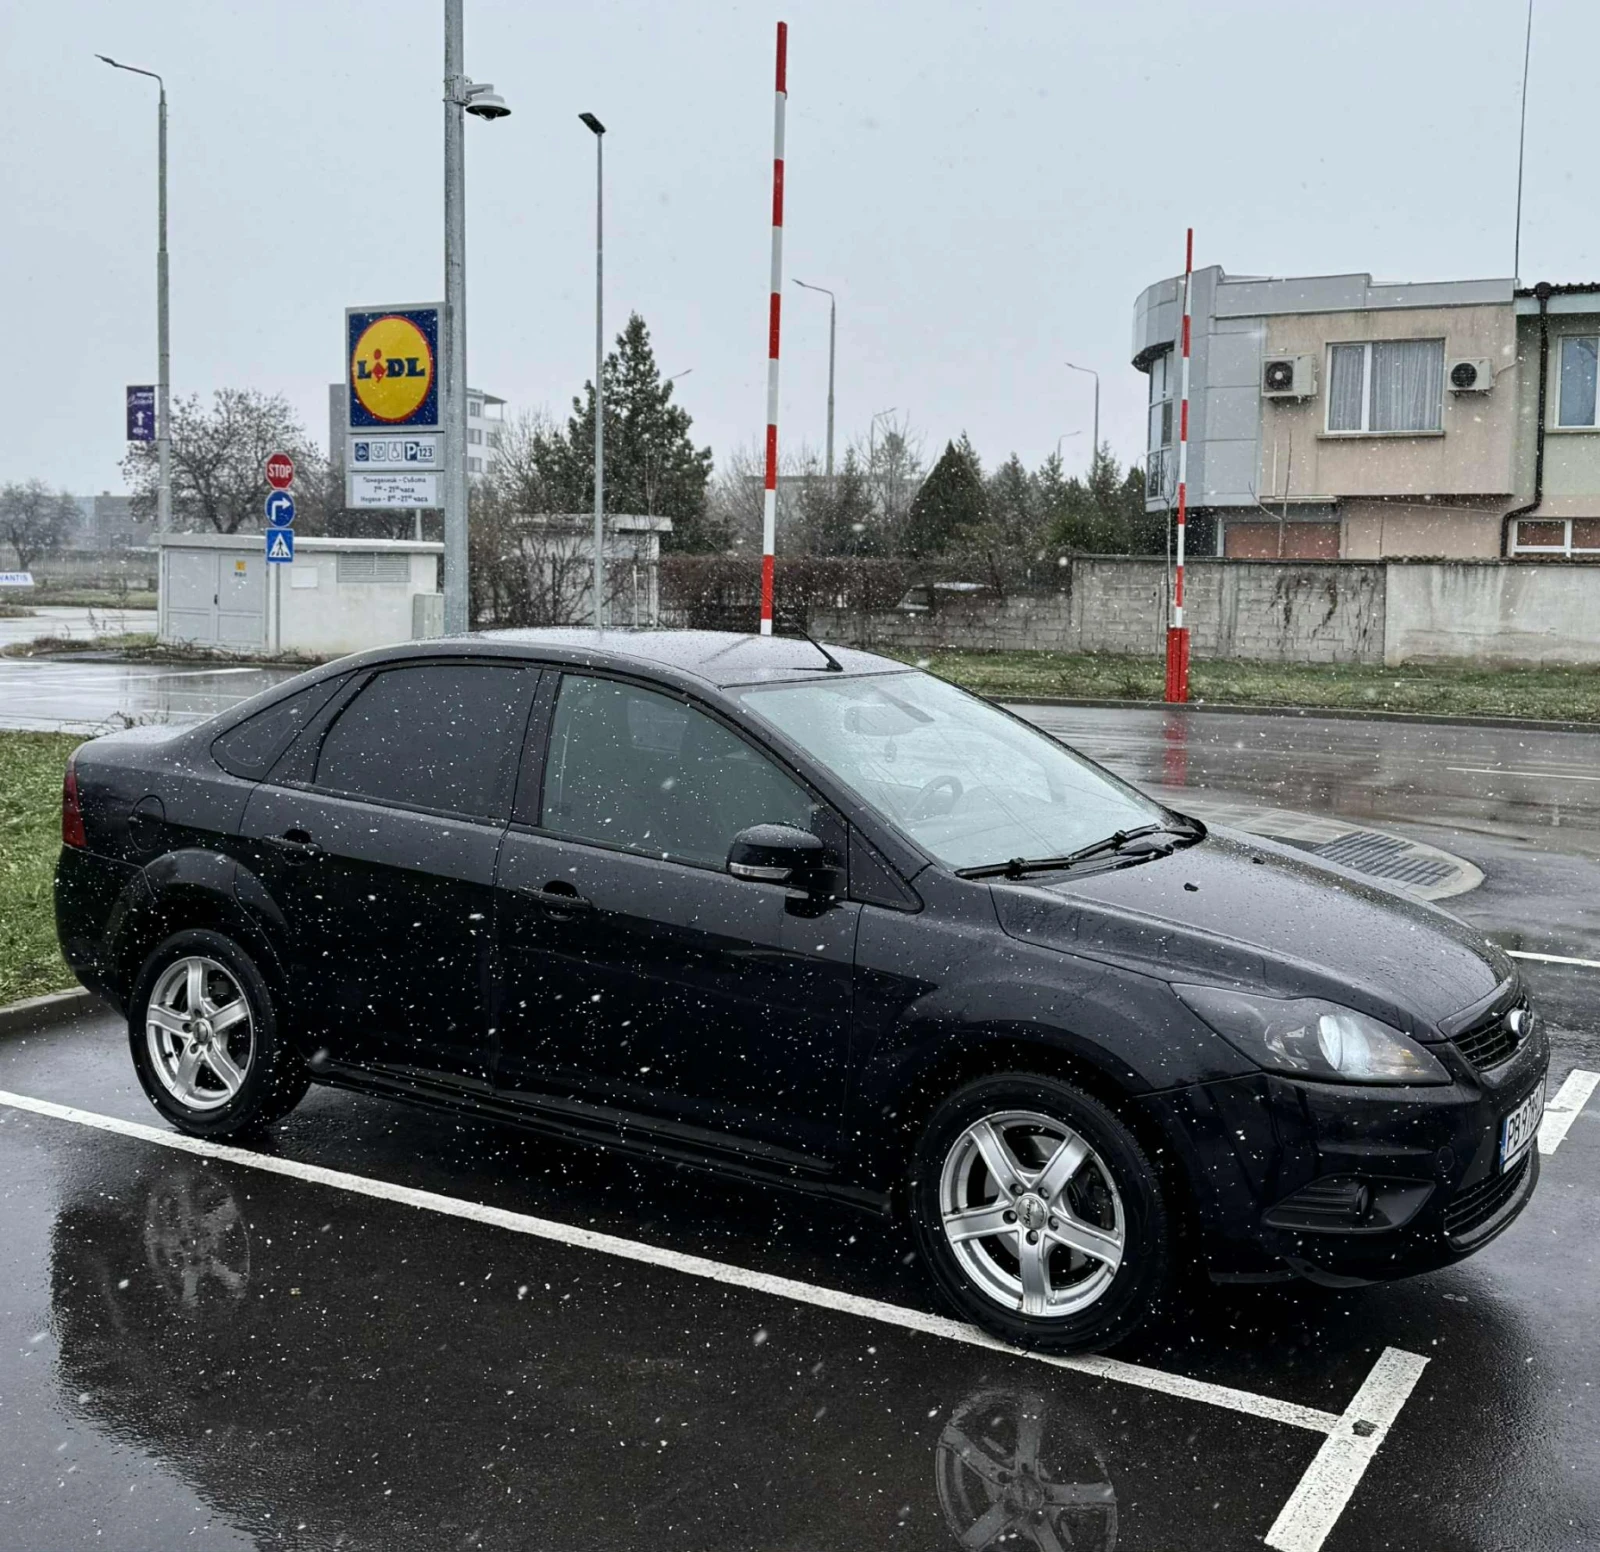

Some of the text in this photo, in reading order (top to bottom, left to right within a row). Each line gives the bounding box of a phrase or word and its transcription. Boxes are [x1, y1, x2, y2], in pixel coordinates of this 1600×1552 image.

[419, 448, 433, 459] 123
[269, 464, 292, 479] STOP
[1507, 1113, 1521, 1153] PB
